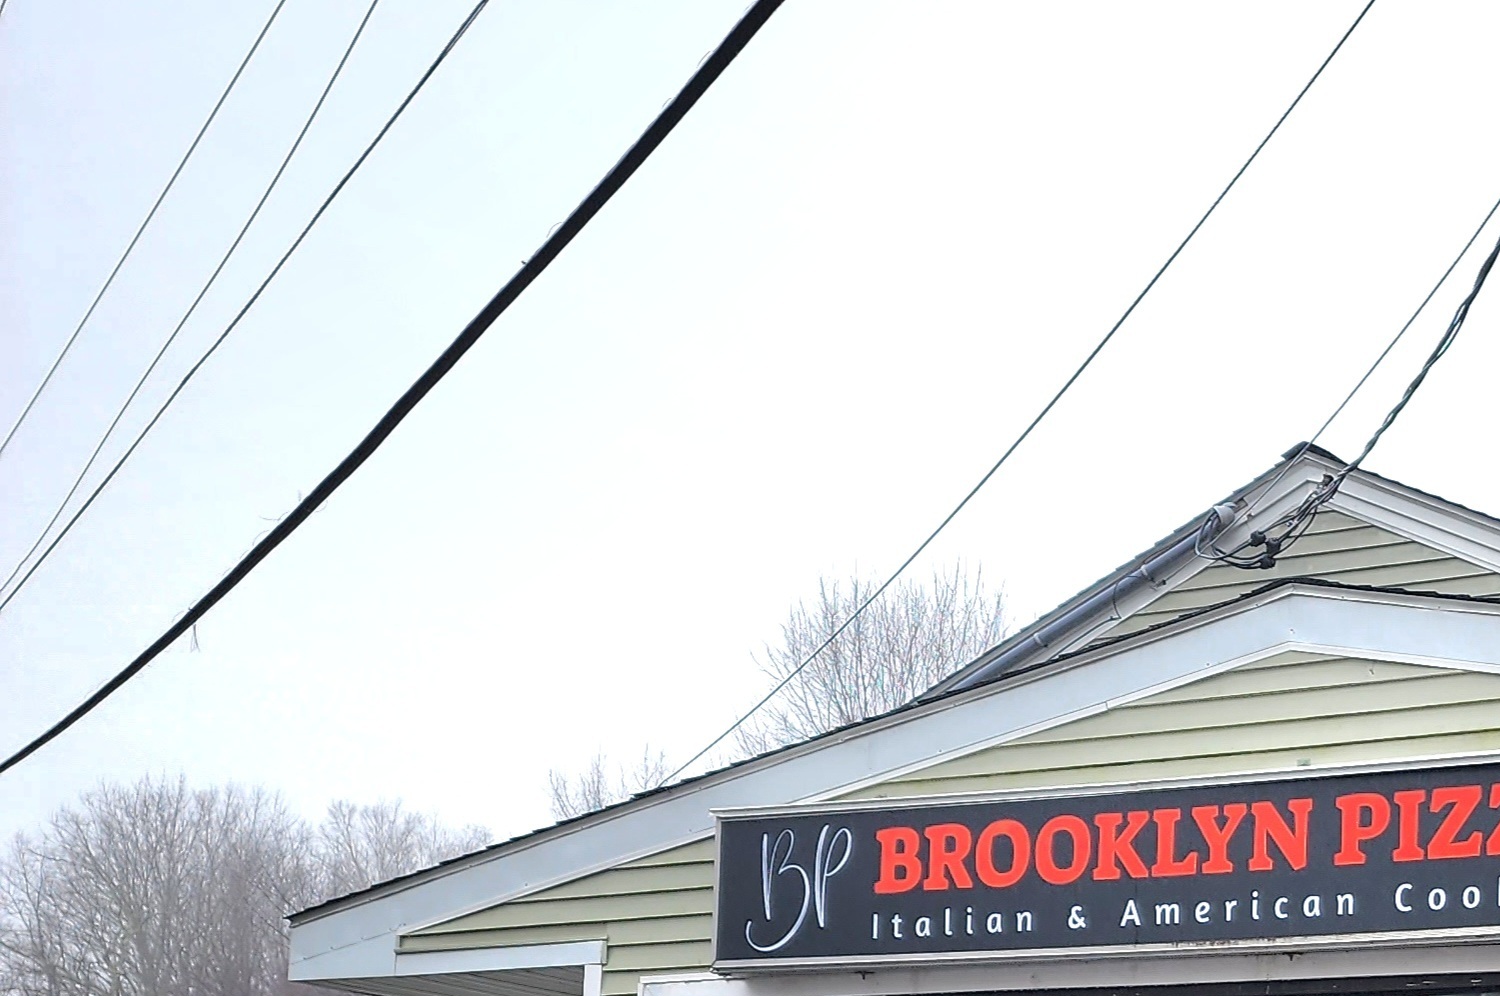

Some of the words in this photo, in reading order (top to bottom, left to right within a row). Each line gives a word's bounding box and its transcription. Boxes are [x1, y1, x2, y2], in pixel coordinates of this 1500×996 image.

[745, 823, 853, 953] BP
[873, 797, 1314, 895] BROOKLYN
[870, 906, 1034, 941] Italian
[1066, 904, 1087, 930] &
[1119, 889, 1356, 928] American
